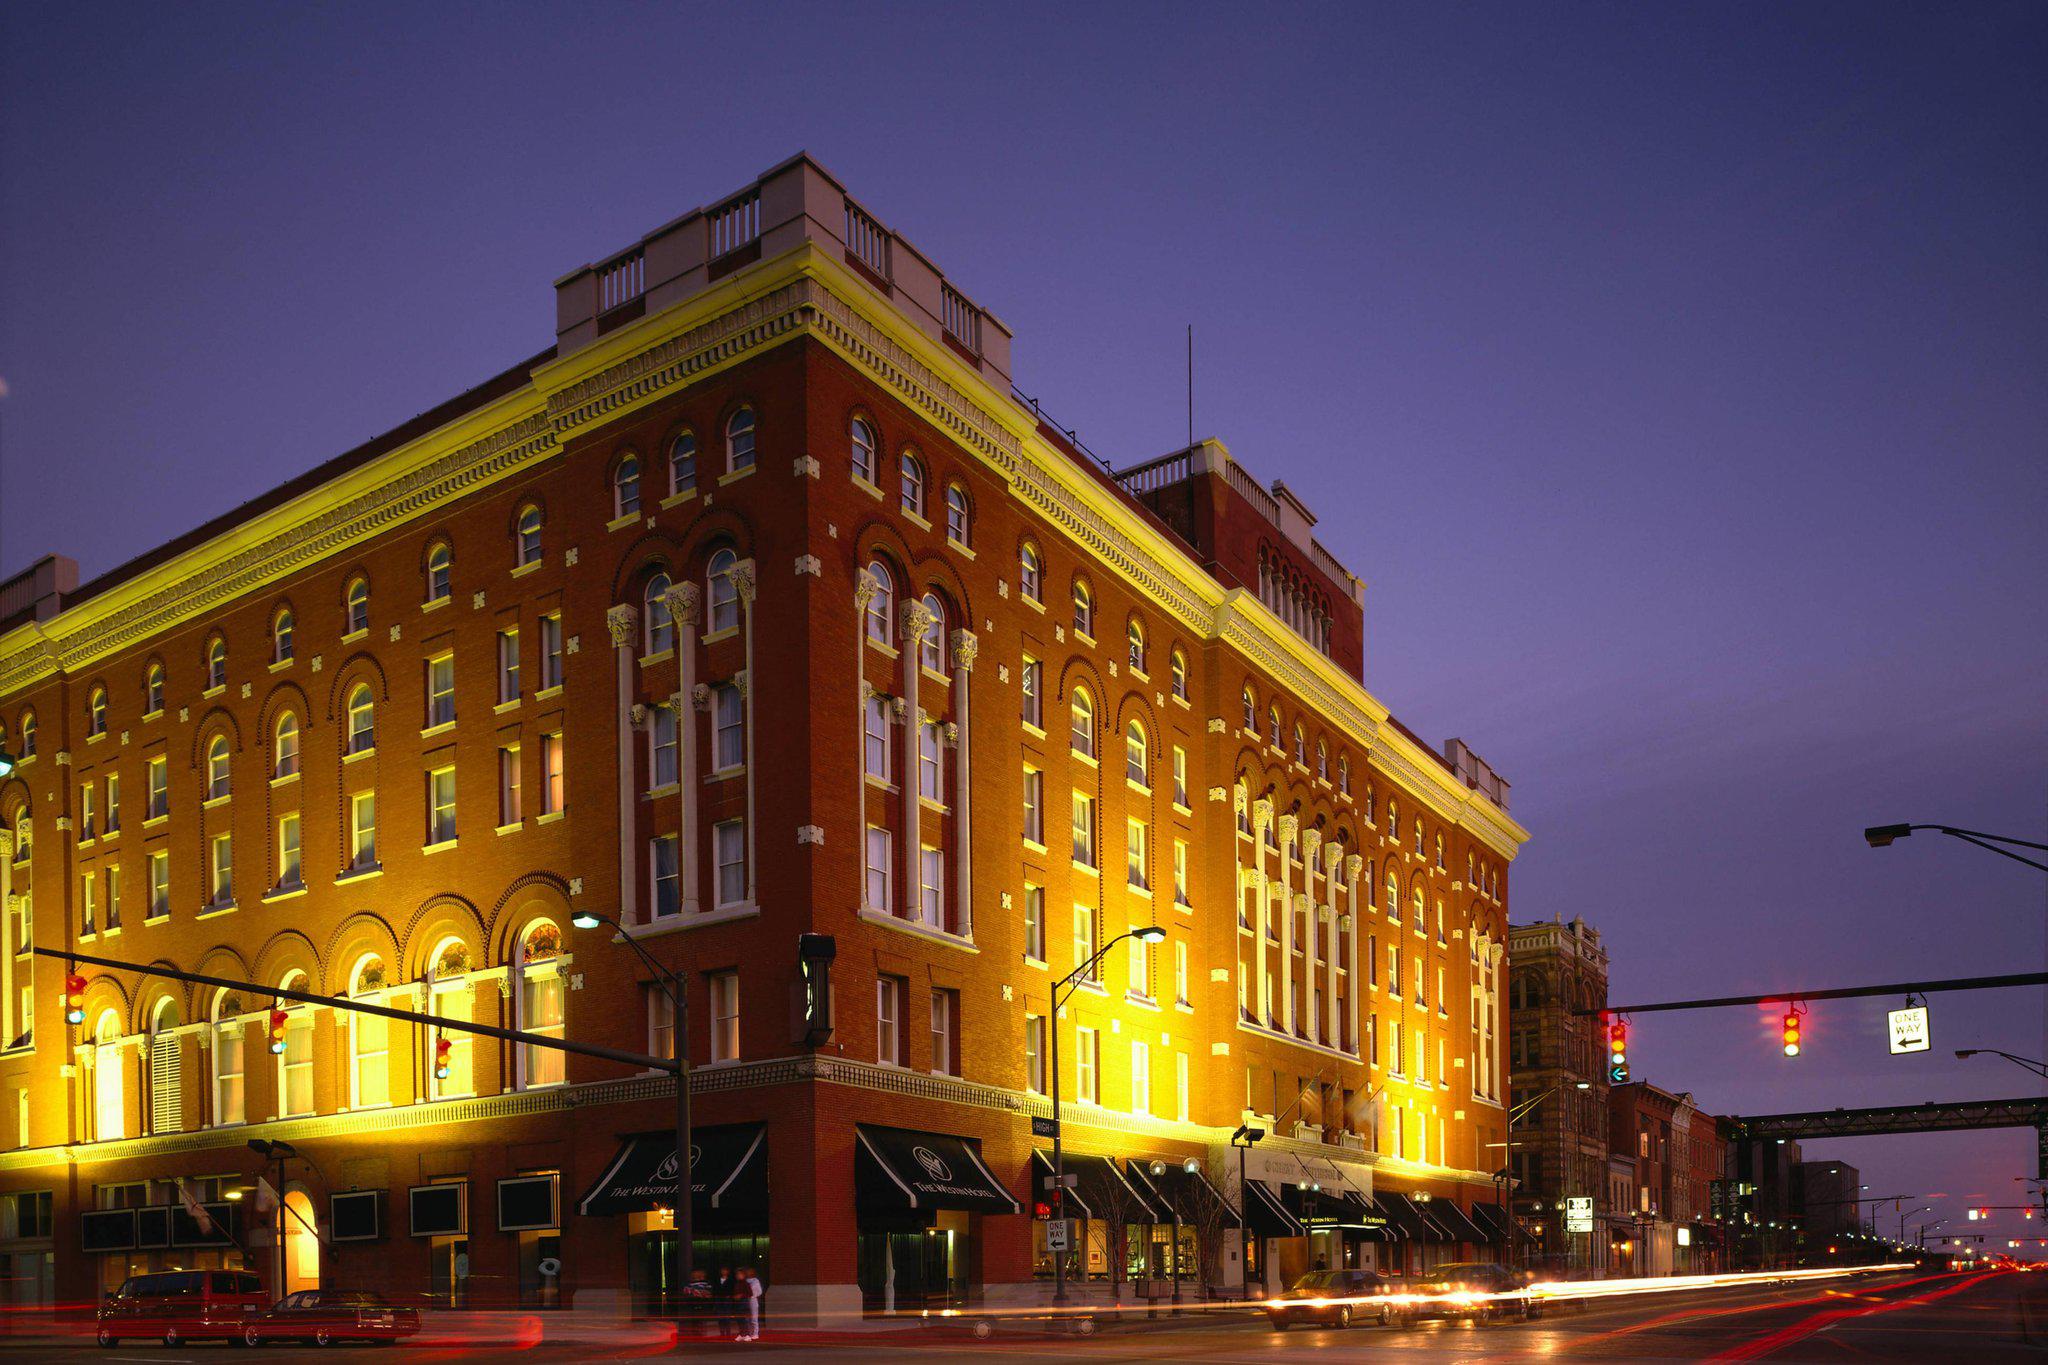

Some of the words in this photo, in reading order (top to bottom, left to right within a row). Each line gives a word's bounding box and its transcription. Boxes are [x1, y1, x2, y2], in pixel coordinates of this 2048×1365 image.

[1895, 1011, 1920, 1023] ONE
[1895, 1023, 1921, 1035] WAY
[1036, 1121, 1050, 1133] HIGH
[610, 1187, 631, 1197] THE
[632, 1185, 671, 1195] WESTIN
[671, 1184, 706, 1193] HTEL
[913, 1182, 937, 1193] THE
[933, 1183, 966, 1195] WESTIN
[964, 1187, 996, 1198] HOTEL
[1049, 1221, 1064, 1231] ONE
[1049, 1231, 1064, 1239] WAY
